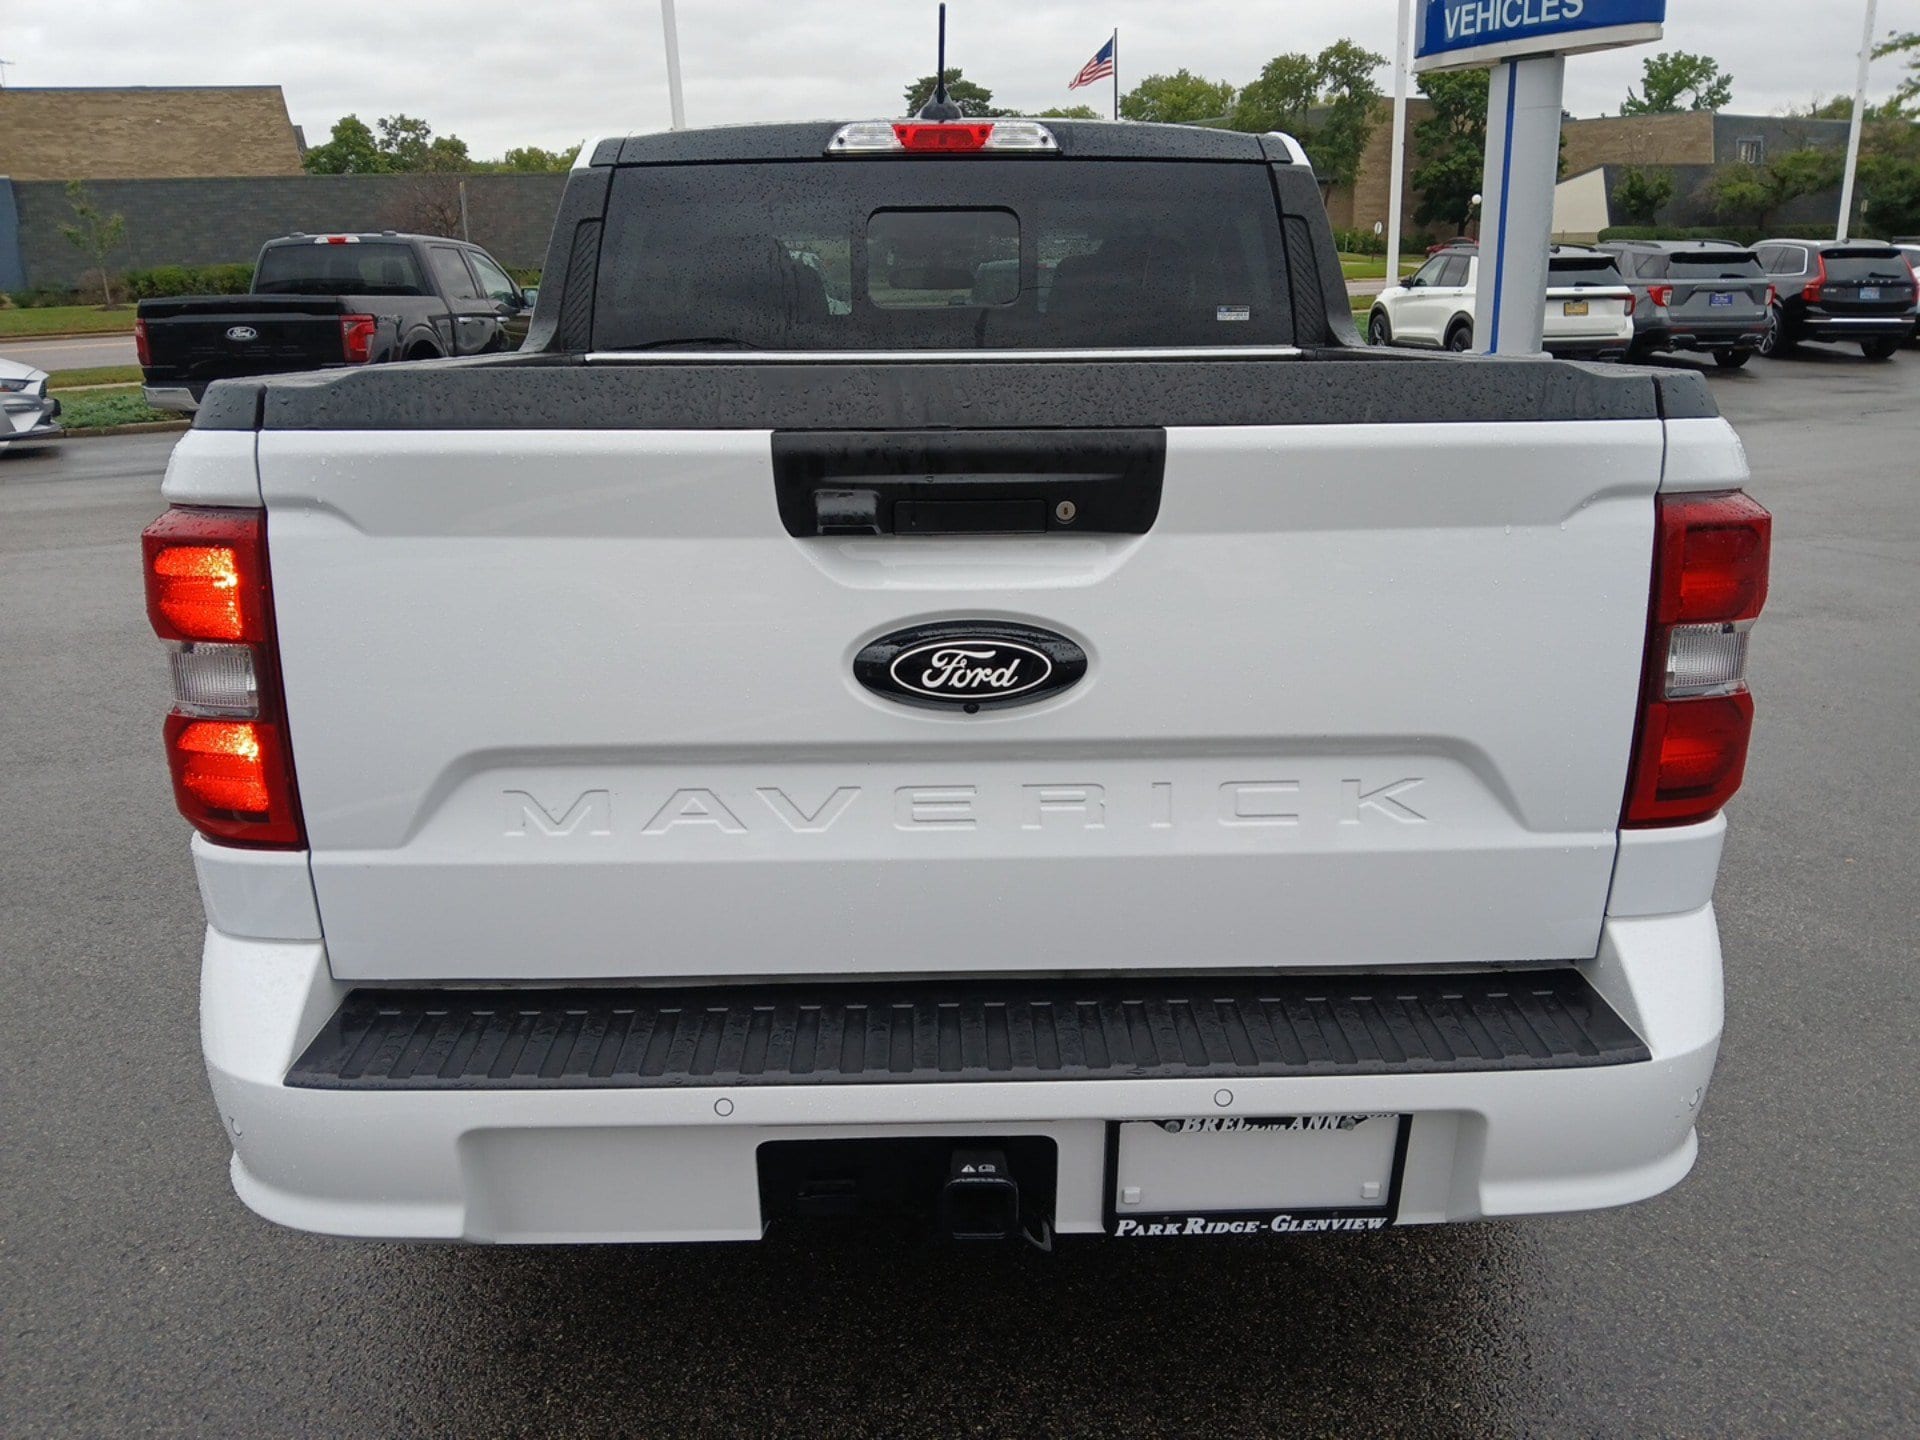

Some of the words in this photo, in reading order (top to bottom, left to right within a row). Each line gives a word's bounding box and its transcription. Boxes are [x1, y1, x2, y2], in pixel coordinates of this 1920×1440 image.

[1444, 0, 1584, 39] VEHICLES
[921, 649, 1021, 689] Ford
[502, 777, 1428, 836] MAVERICK
[1114, 1218, 1183, 1237] PARK
